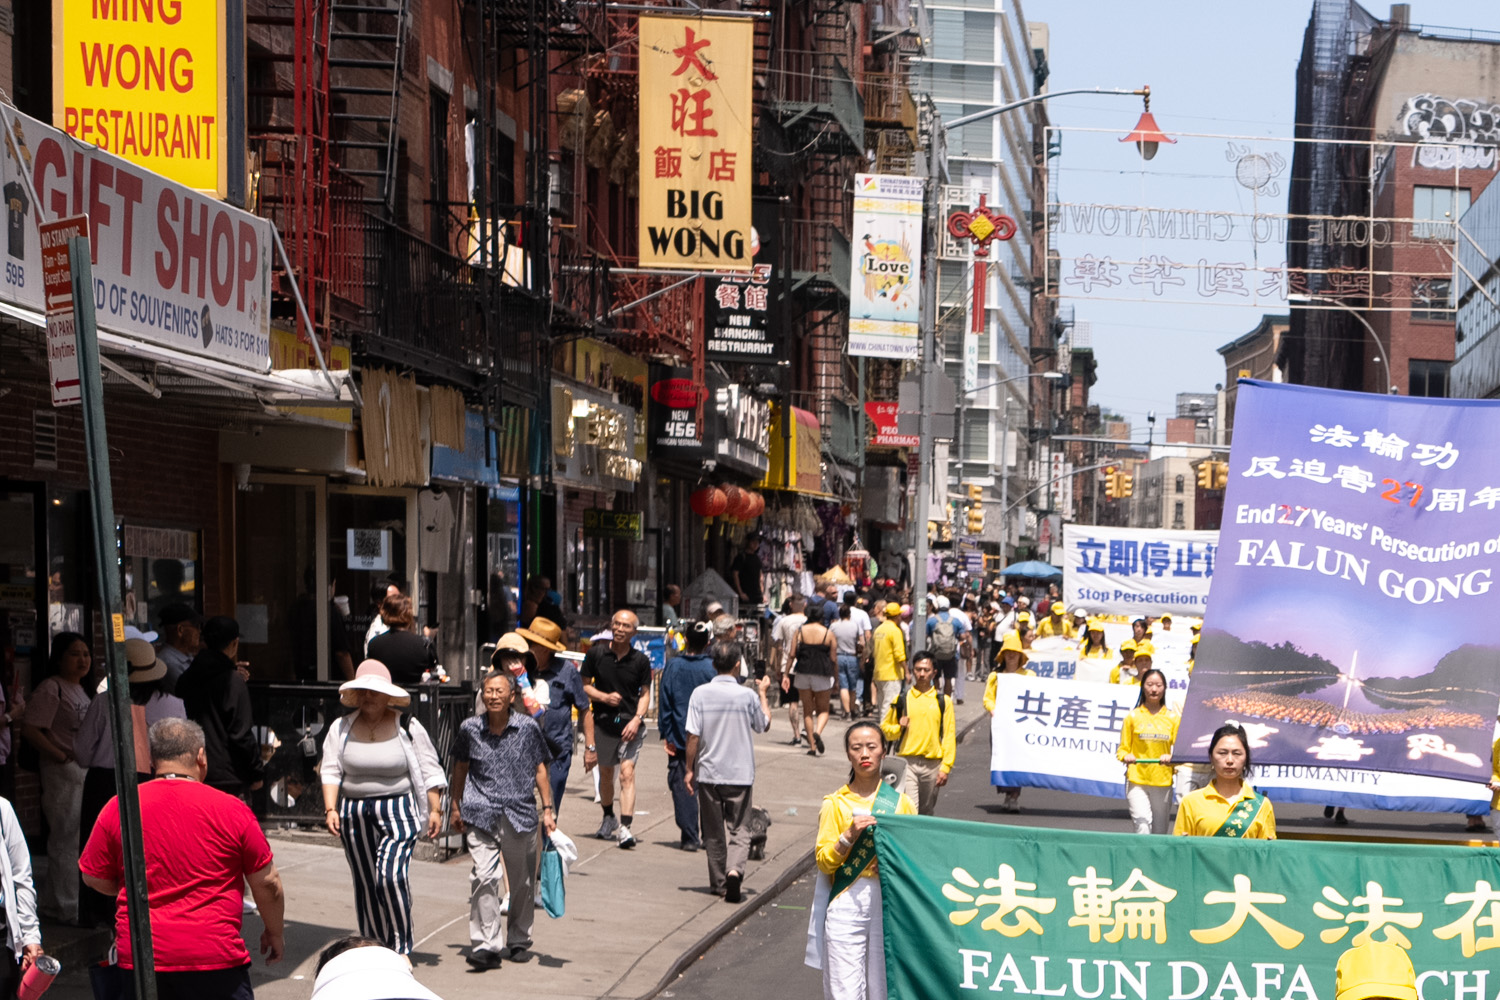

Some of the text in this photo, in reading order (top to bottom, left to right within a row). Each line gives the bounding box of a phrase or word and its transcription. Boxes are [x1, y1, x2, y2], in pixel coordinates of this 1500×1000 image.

[80, 42, 195, 94] WONG
[671, 26, 719, 138] 大旺
[65, 107, 216, 161] RESTAURANT
[653, 145, 738, 182] 飯店
[667, 189, 724, 221] BIG
[33, 137, 259, 313] GIFT SHOP
[42, 232, 51, 250] NO
[647, 226, 746, 260] WONG
[5, 261, 25, 289] 59B
[45, 270, 60, 286] Except
[866, 258, 910, 275] Love
[109, 284, 127, 317] OF
[130, 290, 199, 340] SOUVENIRS
[714, 284, 769, 312] 餐館
[50, 319, 76, 337] NO PARK
[714, 328, 766, 341] SHANGHAI
[729, 315, 751, 327] NEW
[51, 342, 75, 361] Anytime
[215, 323, 233, 344] HATS
[234, 330, 239, 349] 3
[240, 332, 255, 352] FOR
[256, 336, 269, 358] $10
[708, 340, 775, 355] RESTAURANT
[671, 409, 689, 421] NEW
[664, 421, 696, 438] 456
[1309, 424, 1460, 470] 法輪功
[1236, 504, 1275, 525] End
[1371, 525, 1480, 564] Persecution
[1235, 538, 1494, 605] FALUN GONG
[1078, 587, 1110, 604] Stop
[1114, 590, 1198, 606] Persecution
[1025, 732, 1119, 756] COMMUNI
[1277, 765, 1383, 787] HUMANITY
[957, 948, 1151, 1000] FALUN
